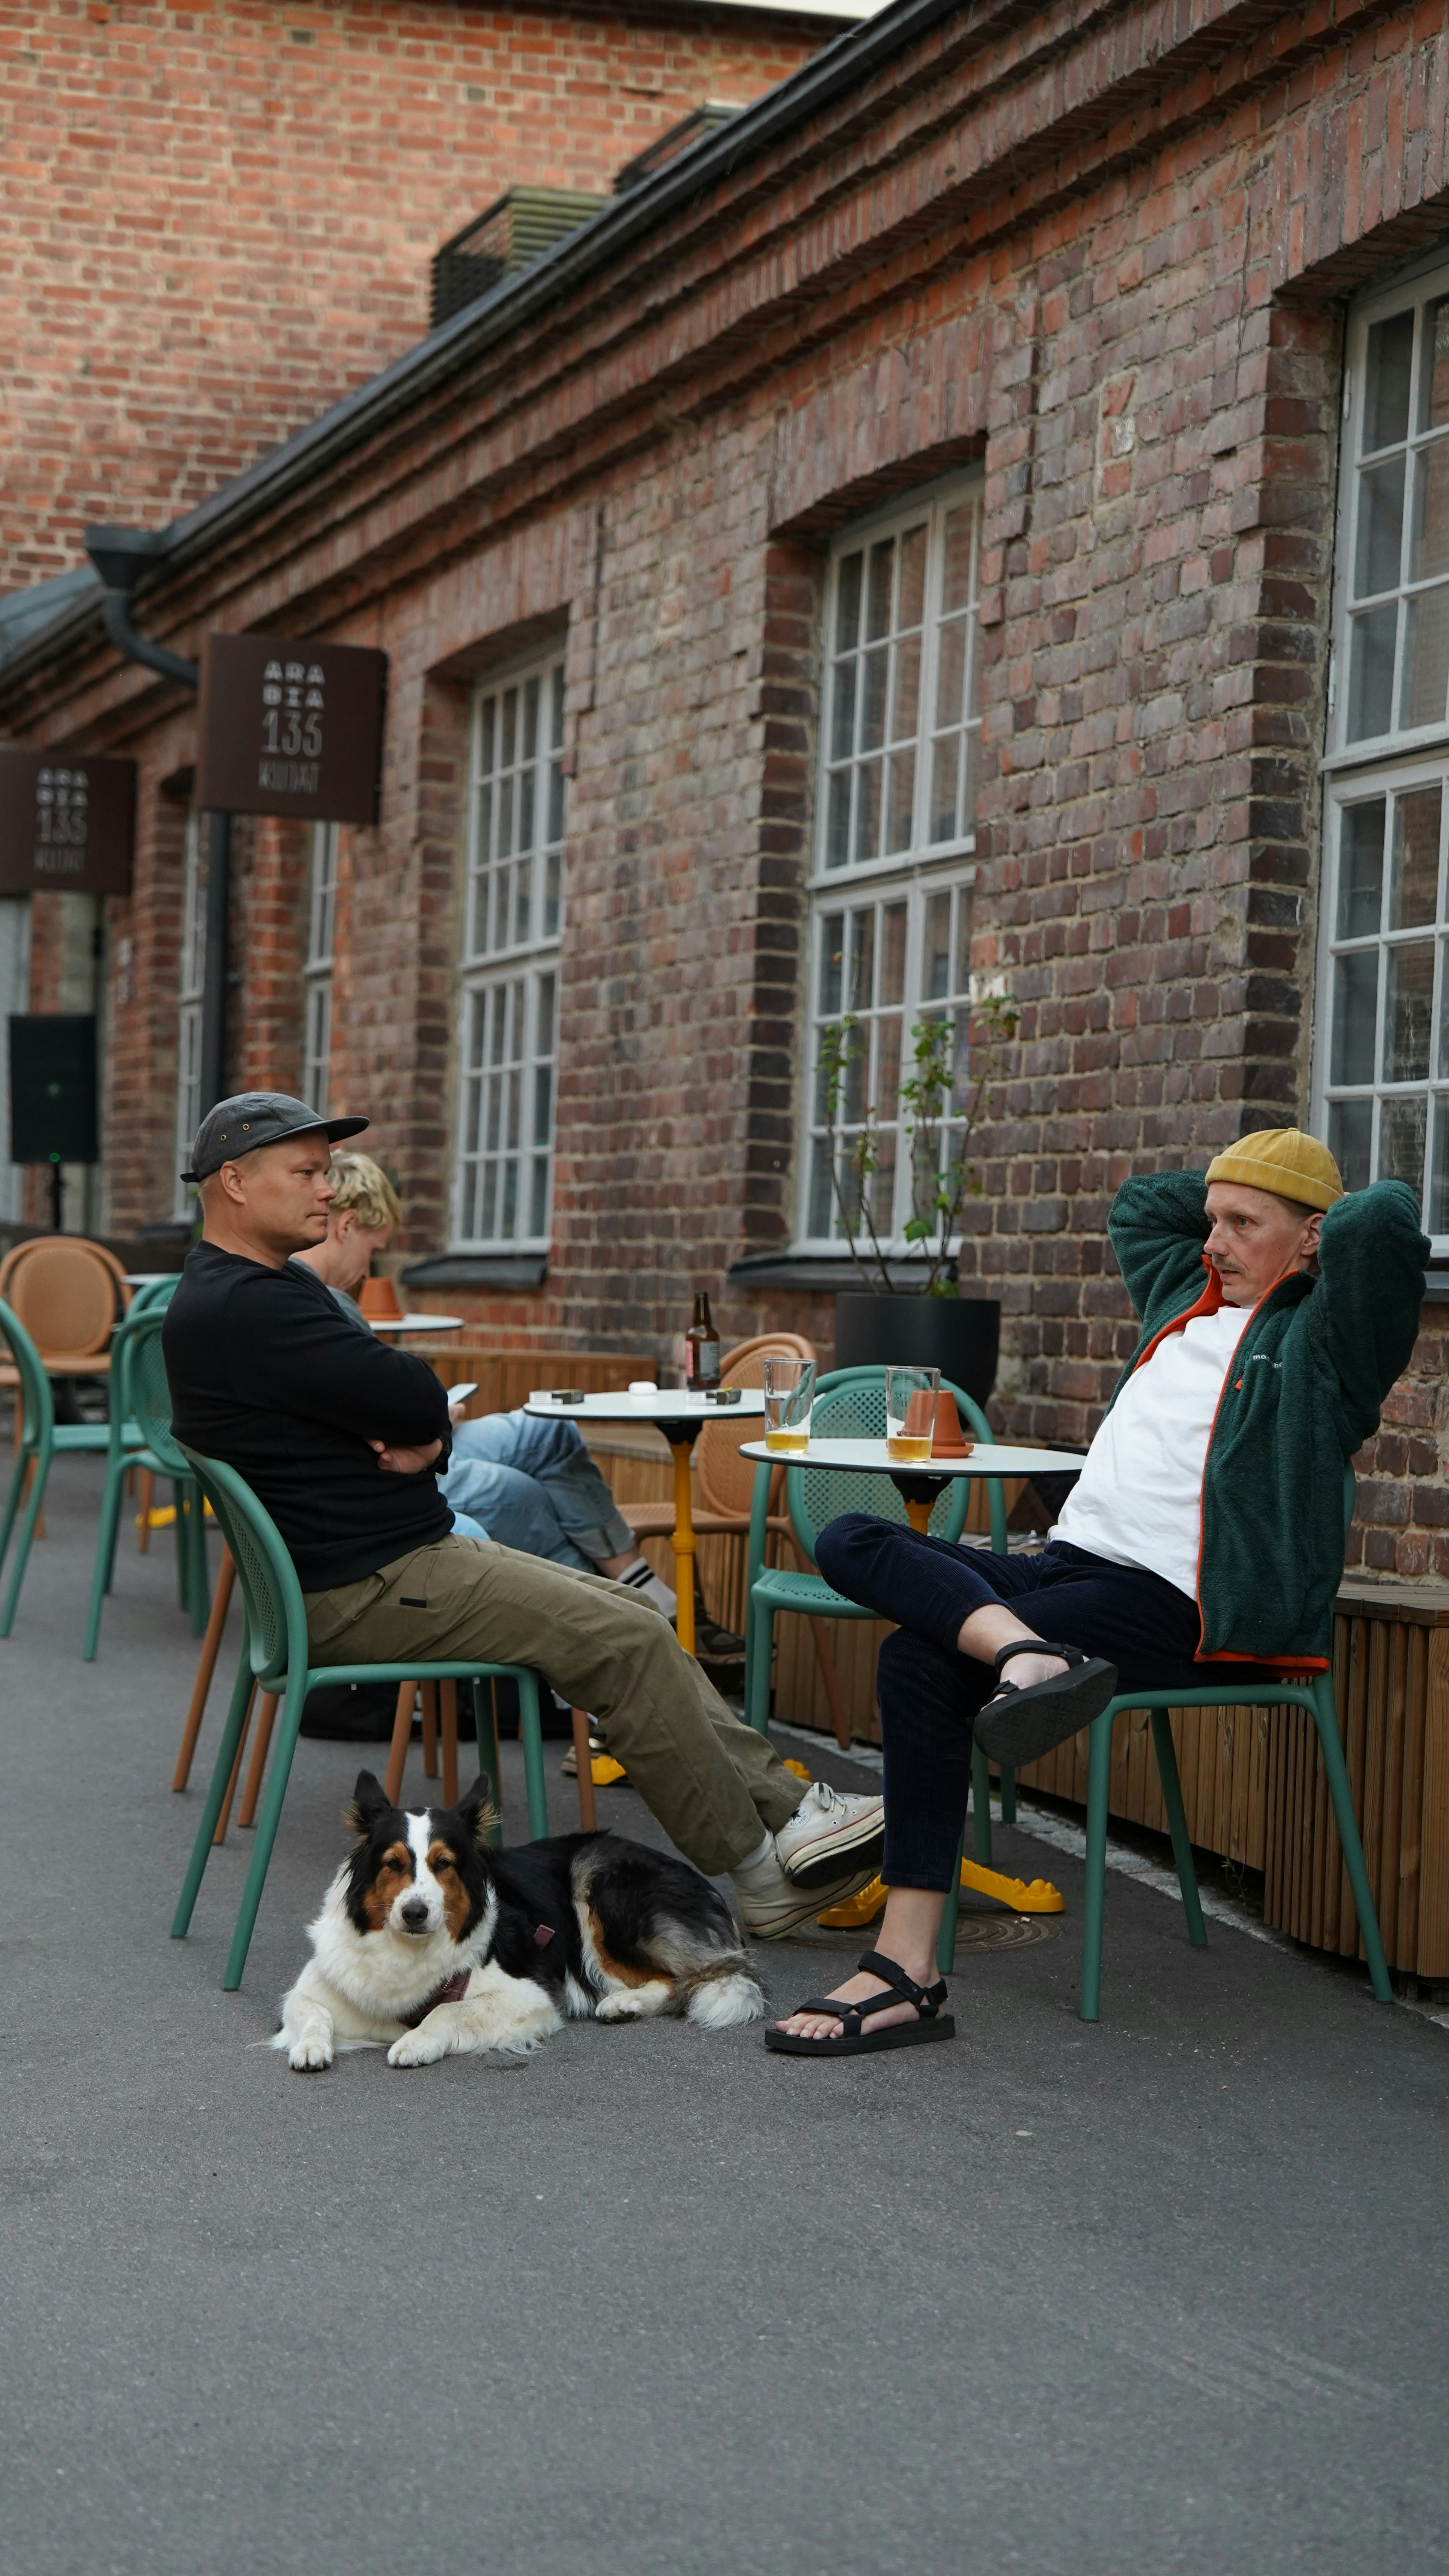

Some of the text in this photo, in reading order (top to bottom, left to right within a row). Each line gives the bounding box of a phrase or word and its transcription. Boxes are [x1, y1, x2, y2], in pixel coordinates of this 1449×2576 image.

[264, 659, 325, 685] ARA
[261, 708, 323, 757] 135
[36, 806, 88, 845] 135
